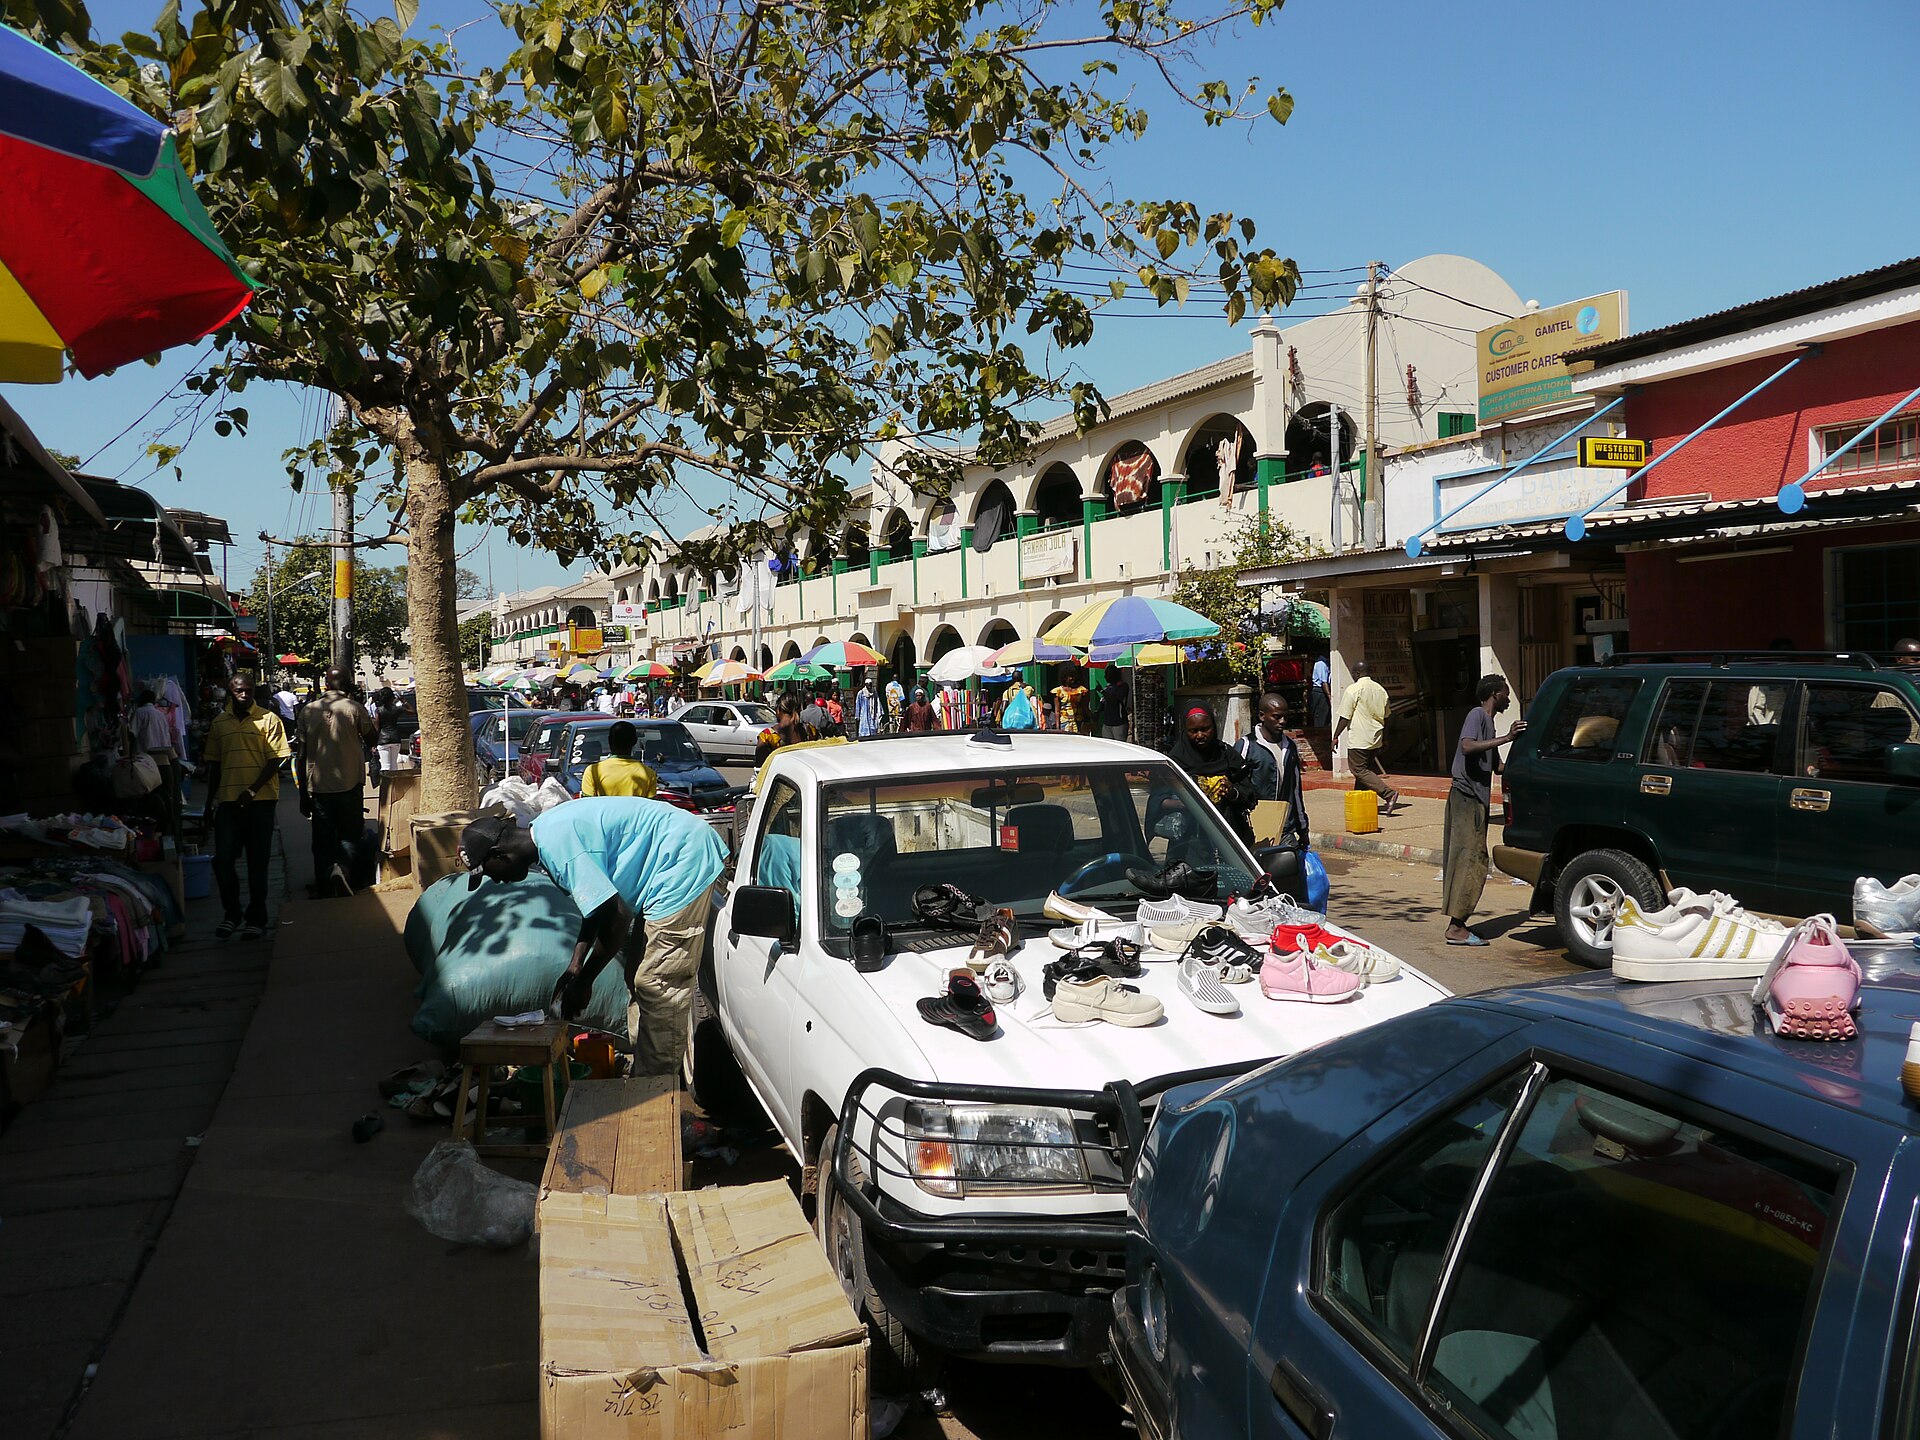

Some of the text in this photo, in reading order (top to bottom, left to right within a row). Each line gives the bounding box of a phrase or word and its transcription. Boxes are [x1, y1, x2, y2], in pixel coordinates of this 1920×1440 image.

[1535, 320, 1573, 337] GAMTEL
[1485, 360, 1529, 384] CUSTOMER
[1531, 353, 1559, 371] CARE
[1509, 378, 1571, 399] INTERNATIONA
[1511, 393, 1549, 409] INTERNET
[1551, 389, 1571, 400] SER
[1595, 443, 1635, 453] WESTERN
[1607, 452, 1635, 462] UNION
